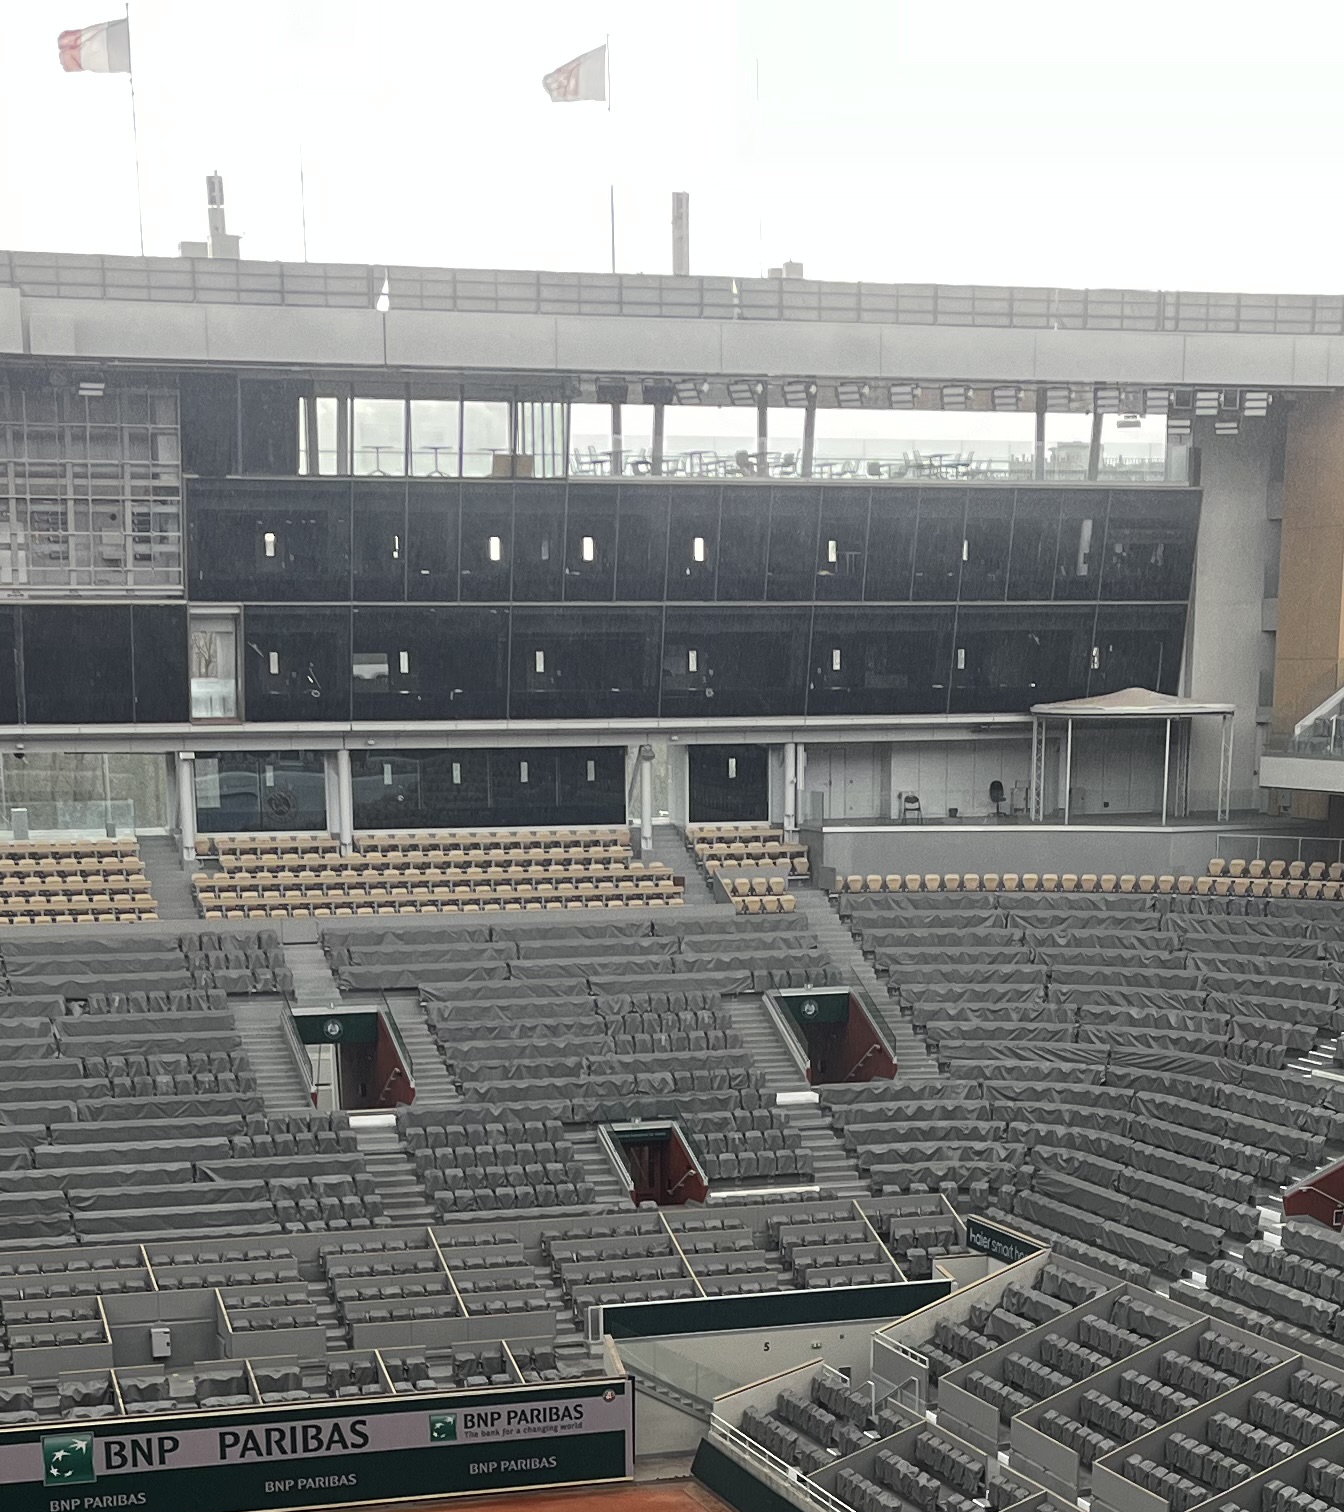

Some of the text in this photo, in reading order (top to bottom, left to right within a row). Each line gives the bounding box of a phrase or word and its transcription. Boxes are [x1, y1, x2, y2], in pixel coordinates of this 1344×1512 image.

[763, 1341, 770, 1352] 5
[463, 1403, 583, 1429] BNP PARIBAS
[464, 1430, 479, 1438] The
[481, 1428, 500, 1437] bank
[502, 1427, 514, 1437] for
[523, 1424, 558, 1434] changing
[560, 1421, 583, 1430] world
[104, 1419, 369, 1470] BNP PARIBAS
[469, 1456, 557, 1475] BNP PARIBAS
[265, 1473, 356, 1493] BNP PARIBAS
[49, 1492, 146, 1512] BNP PARIBAS
